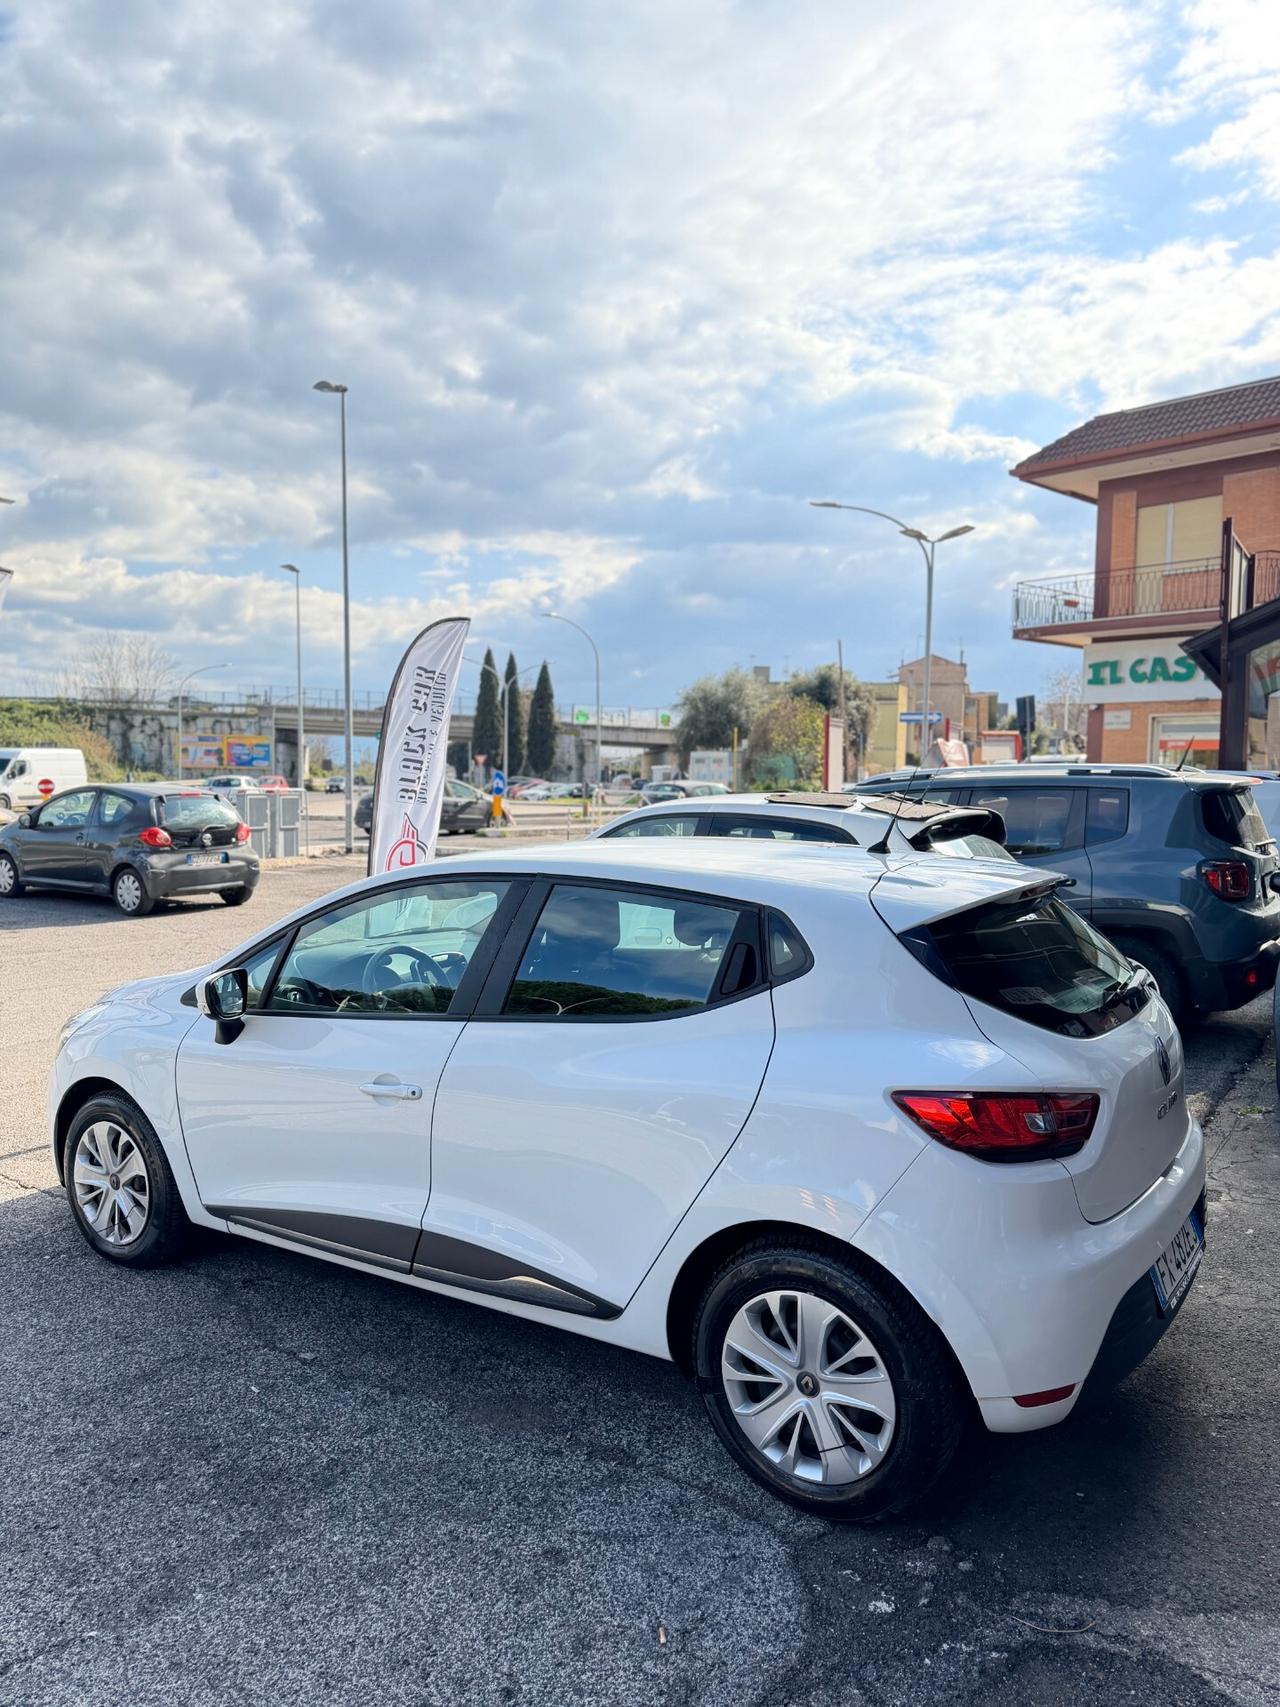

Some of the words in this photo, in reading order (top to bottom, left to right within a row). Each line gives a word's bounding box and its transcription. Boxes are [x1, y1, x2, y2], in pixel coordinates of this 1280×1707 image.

[409, 664, 437, 716] CAR
[1087, 659, 1124, 685] IL
[1129, 655, 1209, 683] CAS
[430, 671, 447, 723] VENDITA
[395, 724, 427, 804] BLACK
